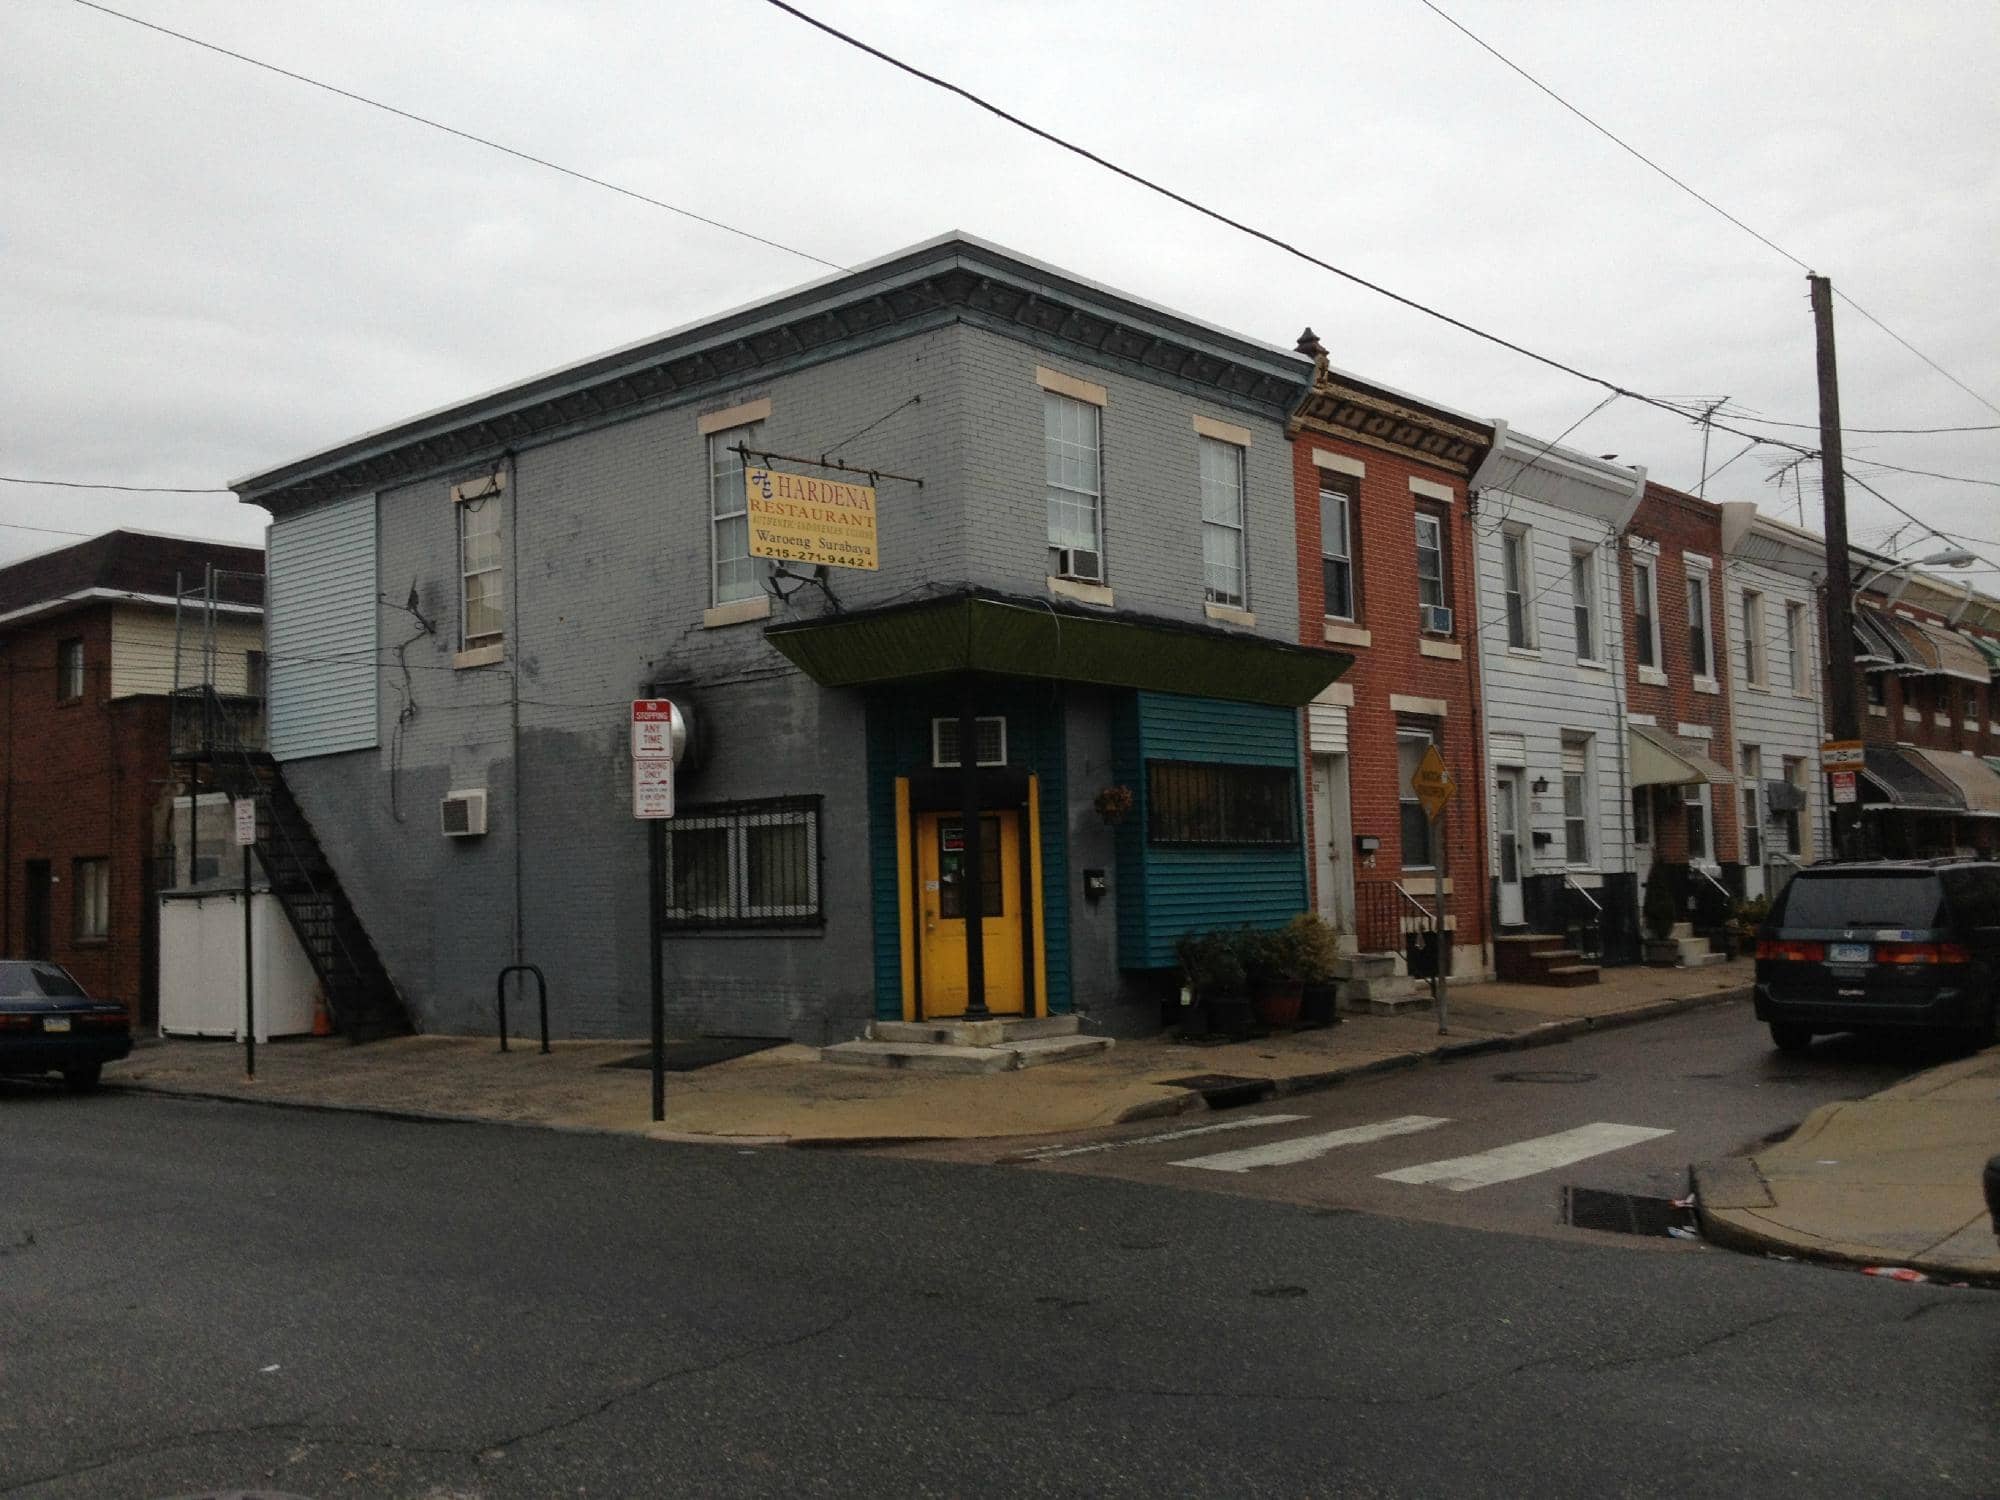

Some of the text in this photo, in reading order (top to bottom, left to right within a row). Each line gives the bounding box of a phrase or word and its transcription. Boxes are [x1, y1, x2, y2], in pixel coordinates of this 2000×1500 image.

[777, 475, 870, 510] HARDENA
[750, 499, 874, 528] RESTAURANT
[756, 529, 871, 556] Waroeng Surabaya
[765, 547, 865, 567] 215-271-9442
[636, 711, 668, 720] STOPPING
[644, 724, 660, 733] ANY
[643, 735, 662, 744] TIME
[638, 762, 667, 770] LOADING
[644, 770, 662, 779] ONLY
